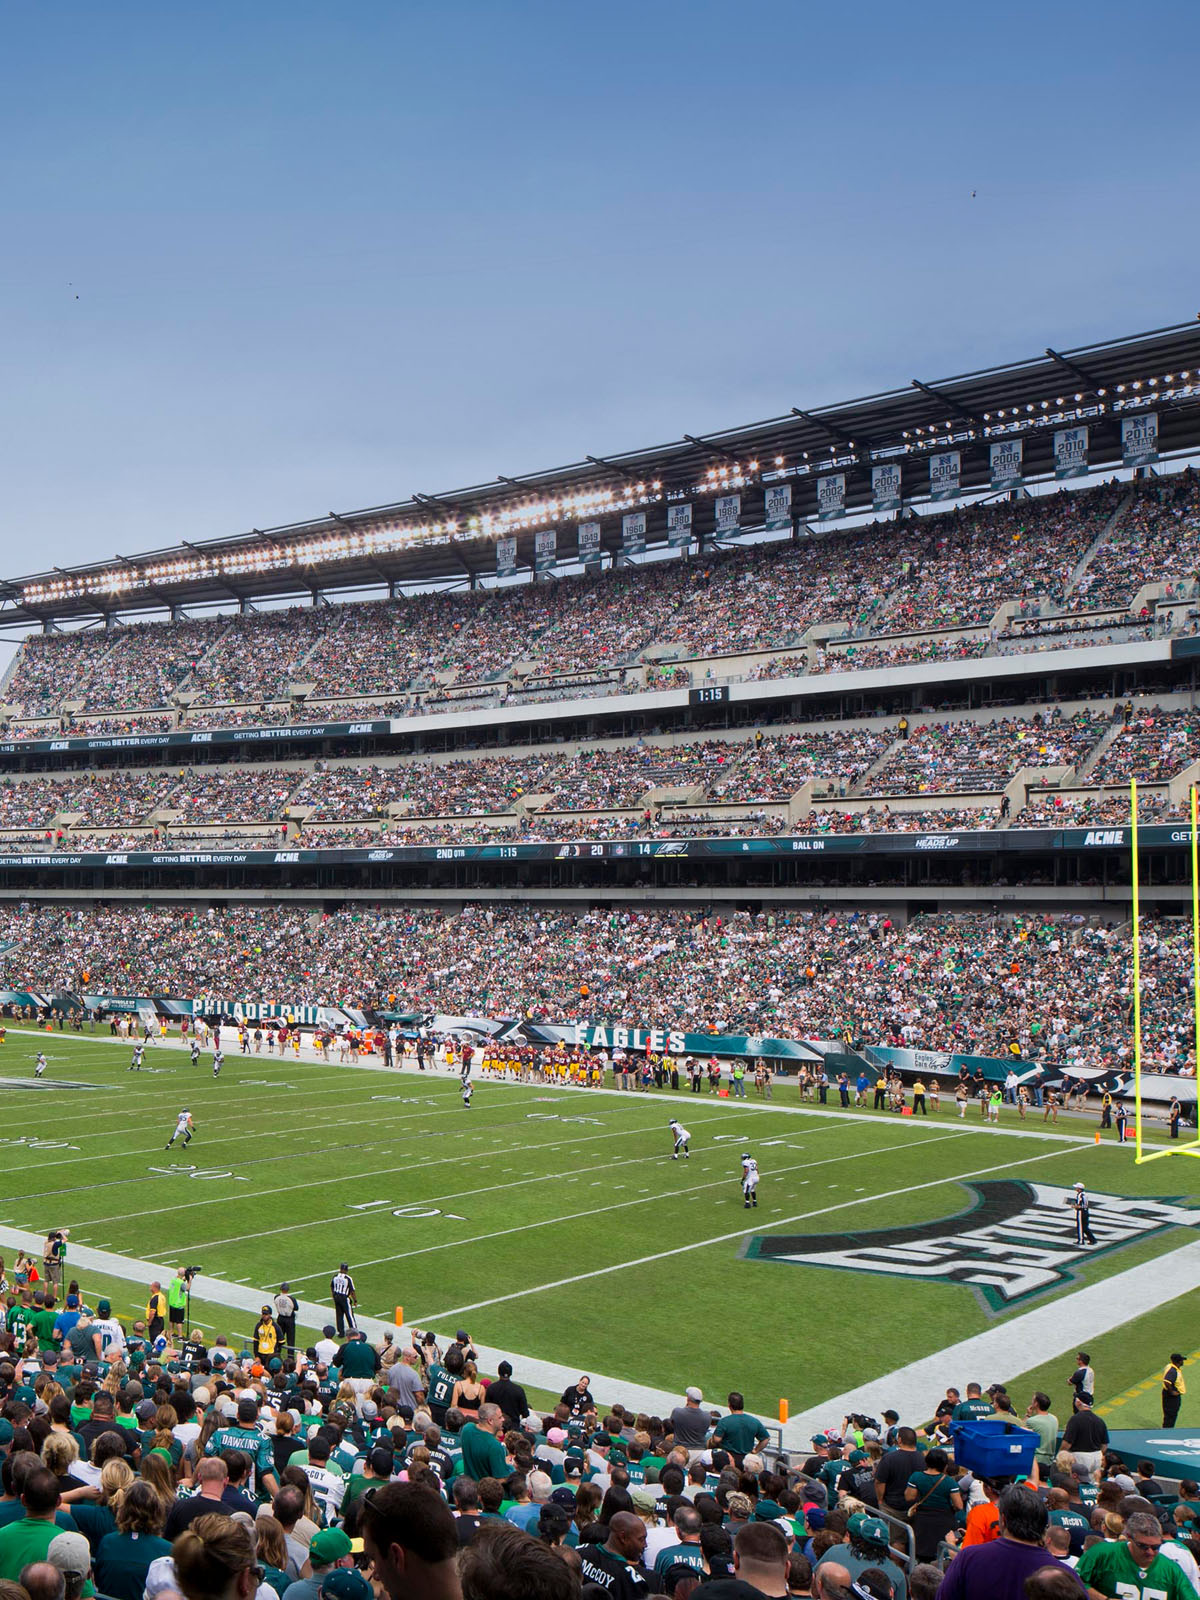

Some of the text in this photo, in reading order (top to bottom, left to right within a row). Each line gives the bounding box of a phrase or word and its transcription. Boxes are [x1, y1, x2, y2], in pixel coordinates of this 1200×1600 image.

[1126, 426, 1155, 440] 2013
[1058, 440, 1084, 453] 2010
[993, 453, 1019, 465] 2006
[933, 464, 958, 476] 2004
[875, 475, 899, 487] 2003
[820, 486, 843, 496] 2002
[768, 498, 788, 507] 2001
[718, 507, 738, 516] 1988
[626, 525, 643, 534] 1960
[581, 533, 598, 542] 1949
[697, 688, 723, 701] 1:15
[260, 729, 291, 738] BETTER
[292, 728, 311, 736] EVERY
[349, 723, 372, 734] ACME
[191, 733, 212, 743] ACME
[50, 742, 70, 750] ACME
[946, 839, 959, 847] UP
[1084, 831, 1124, 845] ACME
[591, 845, 603, 855] 20
[638, 844, 650, 854] 14
[793, 841, 824, 850] BALL ON
[274, 853, 299, 862] ACME
[436, 849, 453, 859] 2ND
[500, 848, 517, 857] 1:15
[106, 855, 128, 864] ACME
[575, 1025, 686, 1052] EAGLES
[344, 1200, 442, 1218] 10
[13, 1322, 26, 1344] 13
[434, 1382, 448, 1400] 9
[221, 1434, 259, 1450] DAWKINS
[581, 1560, 615, 1588] McCOY
